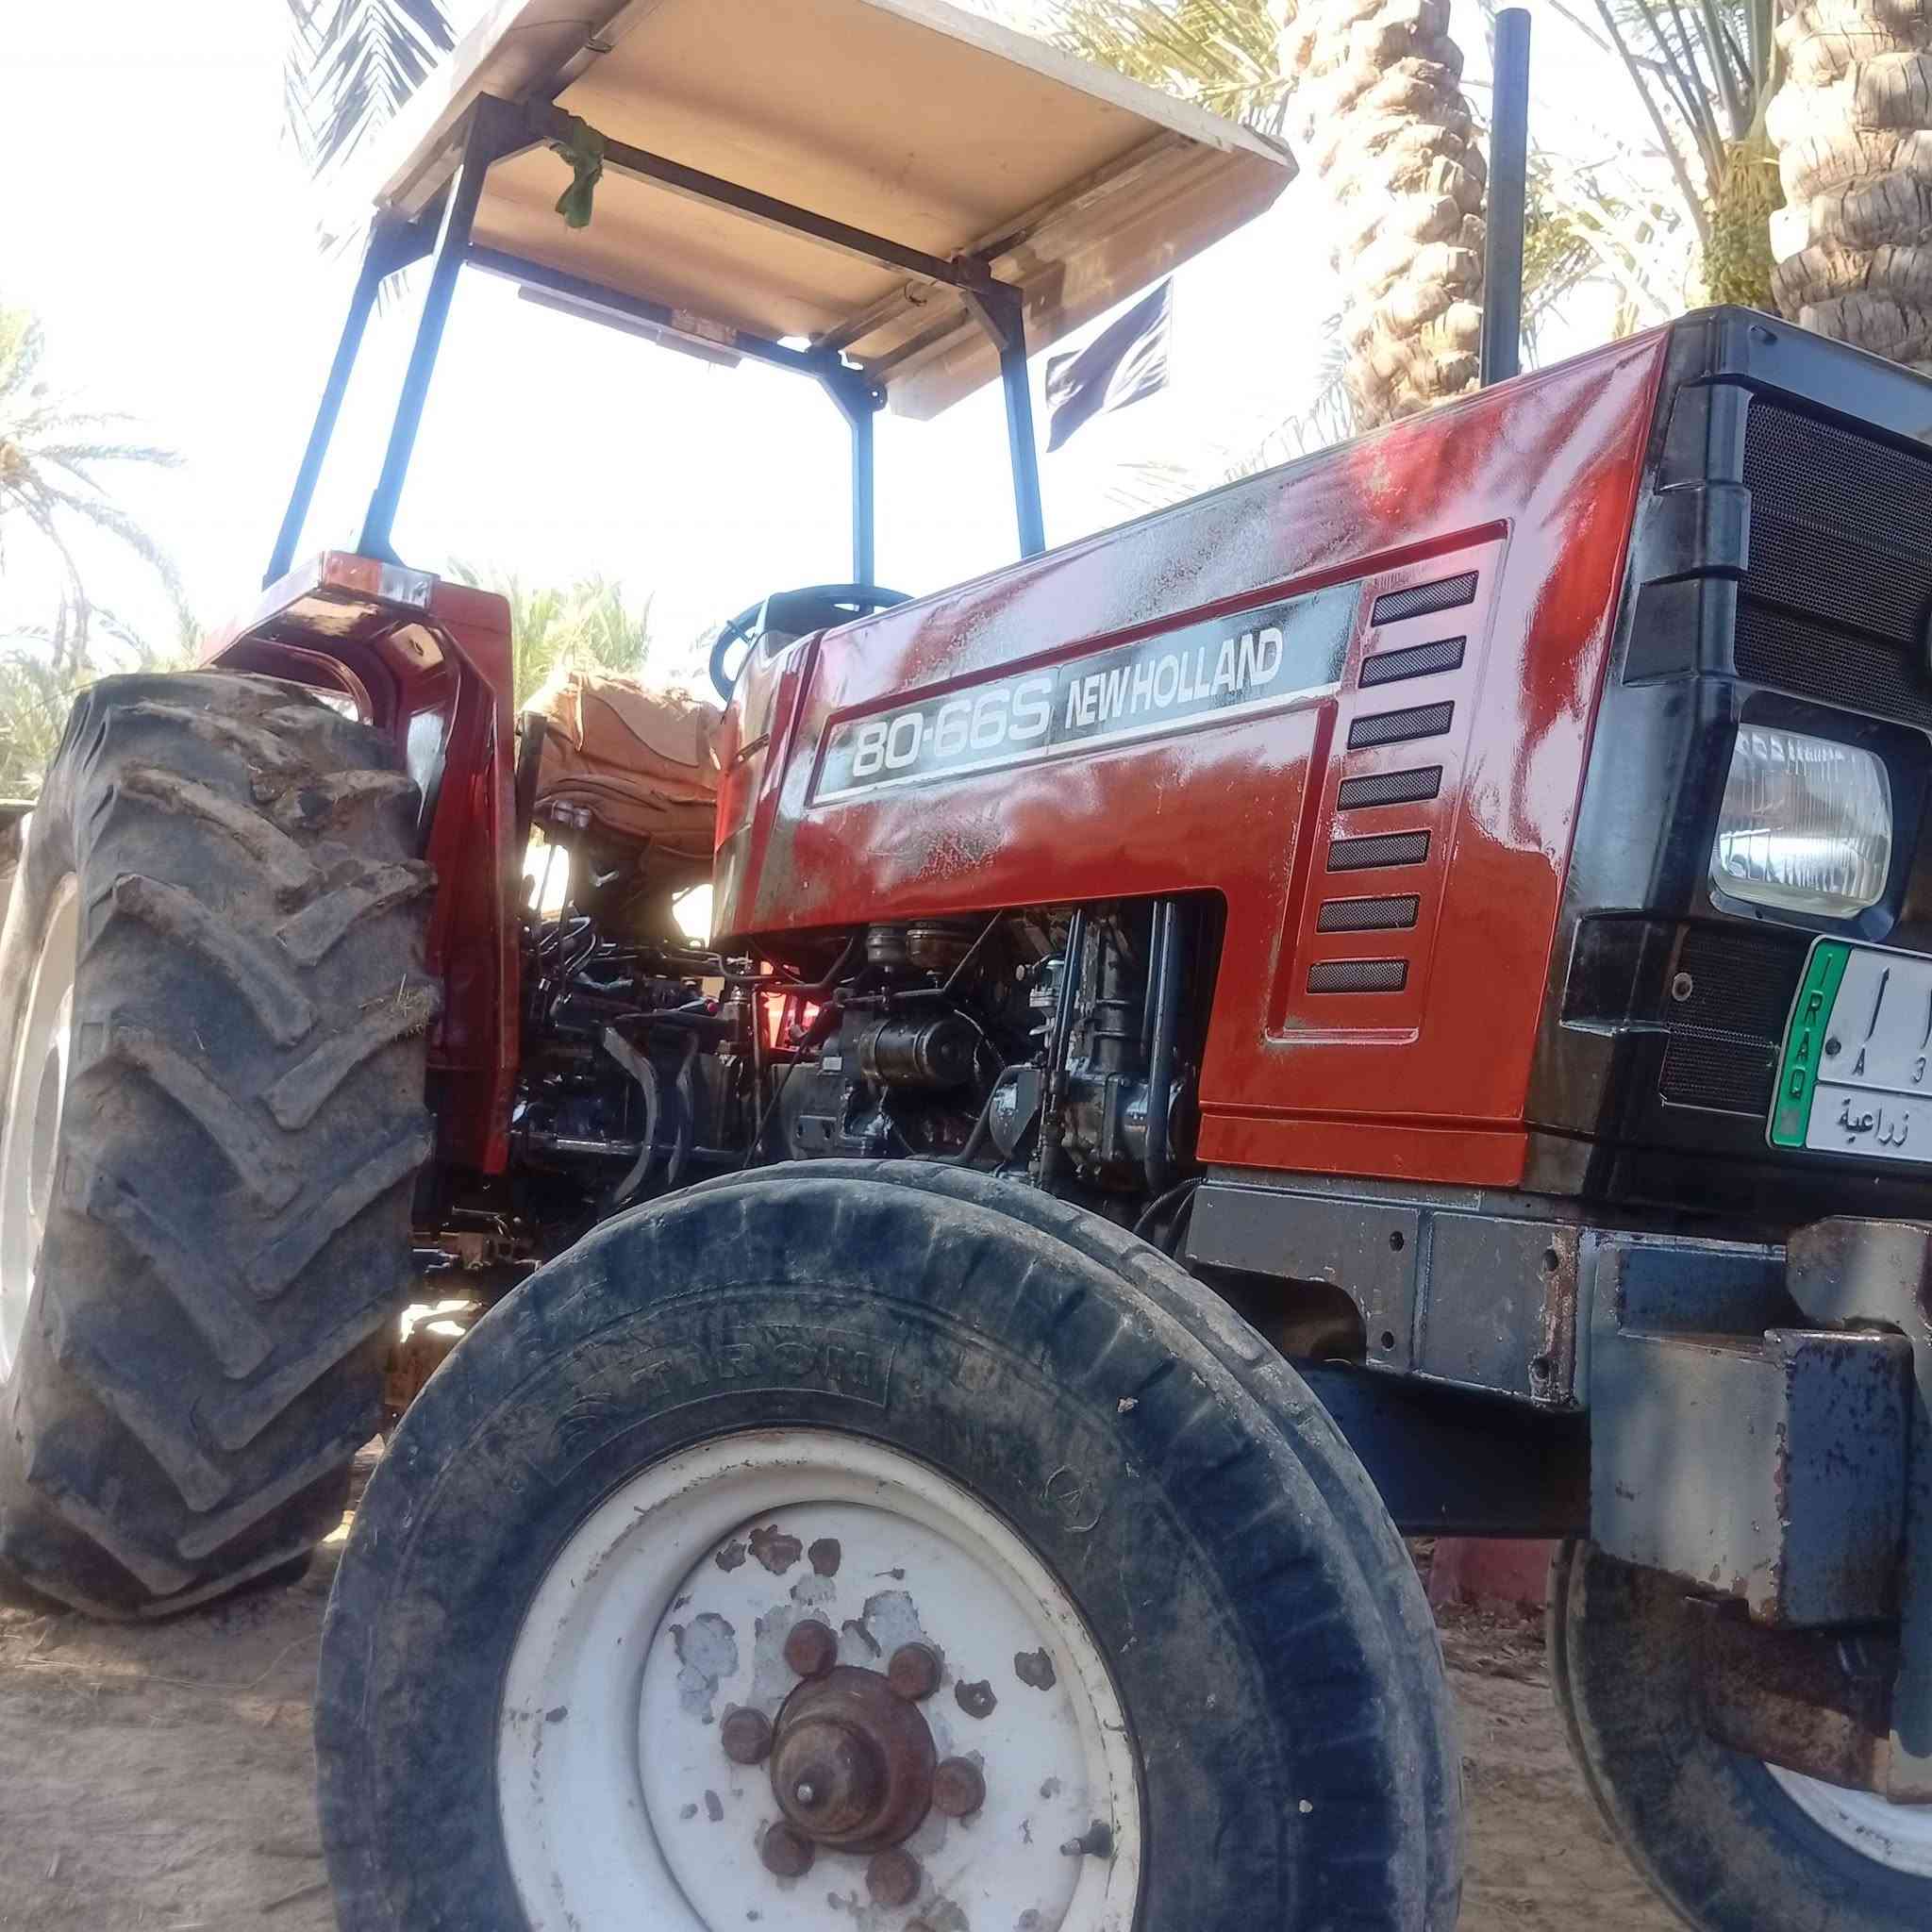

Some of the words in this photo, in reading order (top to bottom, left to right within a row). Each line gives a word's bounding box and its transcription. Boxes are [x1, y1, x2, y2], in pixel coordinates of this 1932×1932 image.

[1065, 665, 1131, 729] NEW
[1130, 627, 1283, 714] HOLLAND
[1789, 953, 1832, 1100] IRAQ
[1838, 1097, 1910, 1148] زراعية
